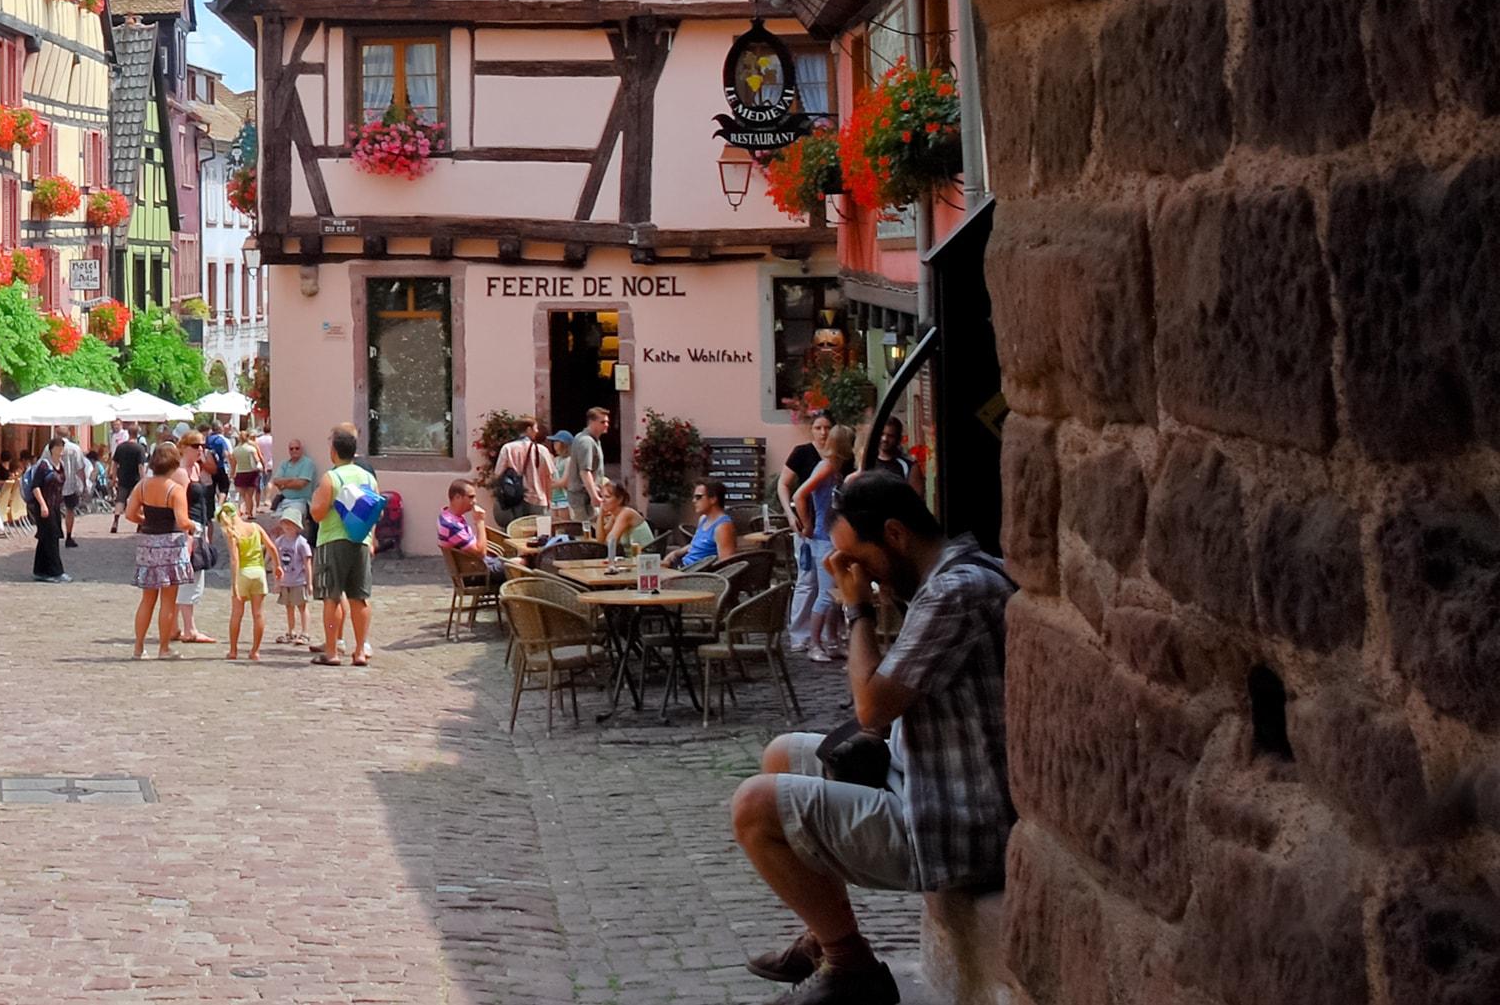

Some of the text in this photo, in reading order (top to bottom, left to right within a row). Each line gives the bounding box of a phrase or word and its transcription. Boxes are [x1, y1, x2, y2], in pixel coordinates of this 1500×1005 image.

[725, 85, 796, 122] LE MEDIEVAL
[730, 132, 796, 146] RESTAURANT
[486, 276, 686, 297] FEERIE DE NOEL
[643, 347, 753, 363] Kathe Wohlfahrt
